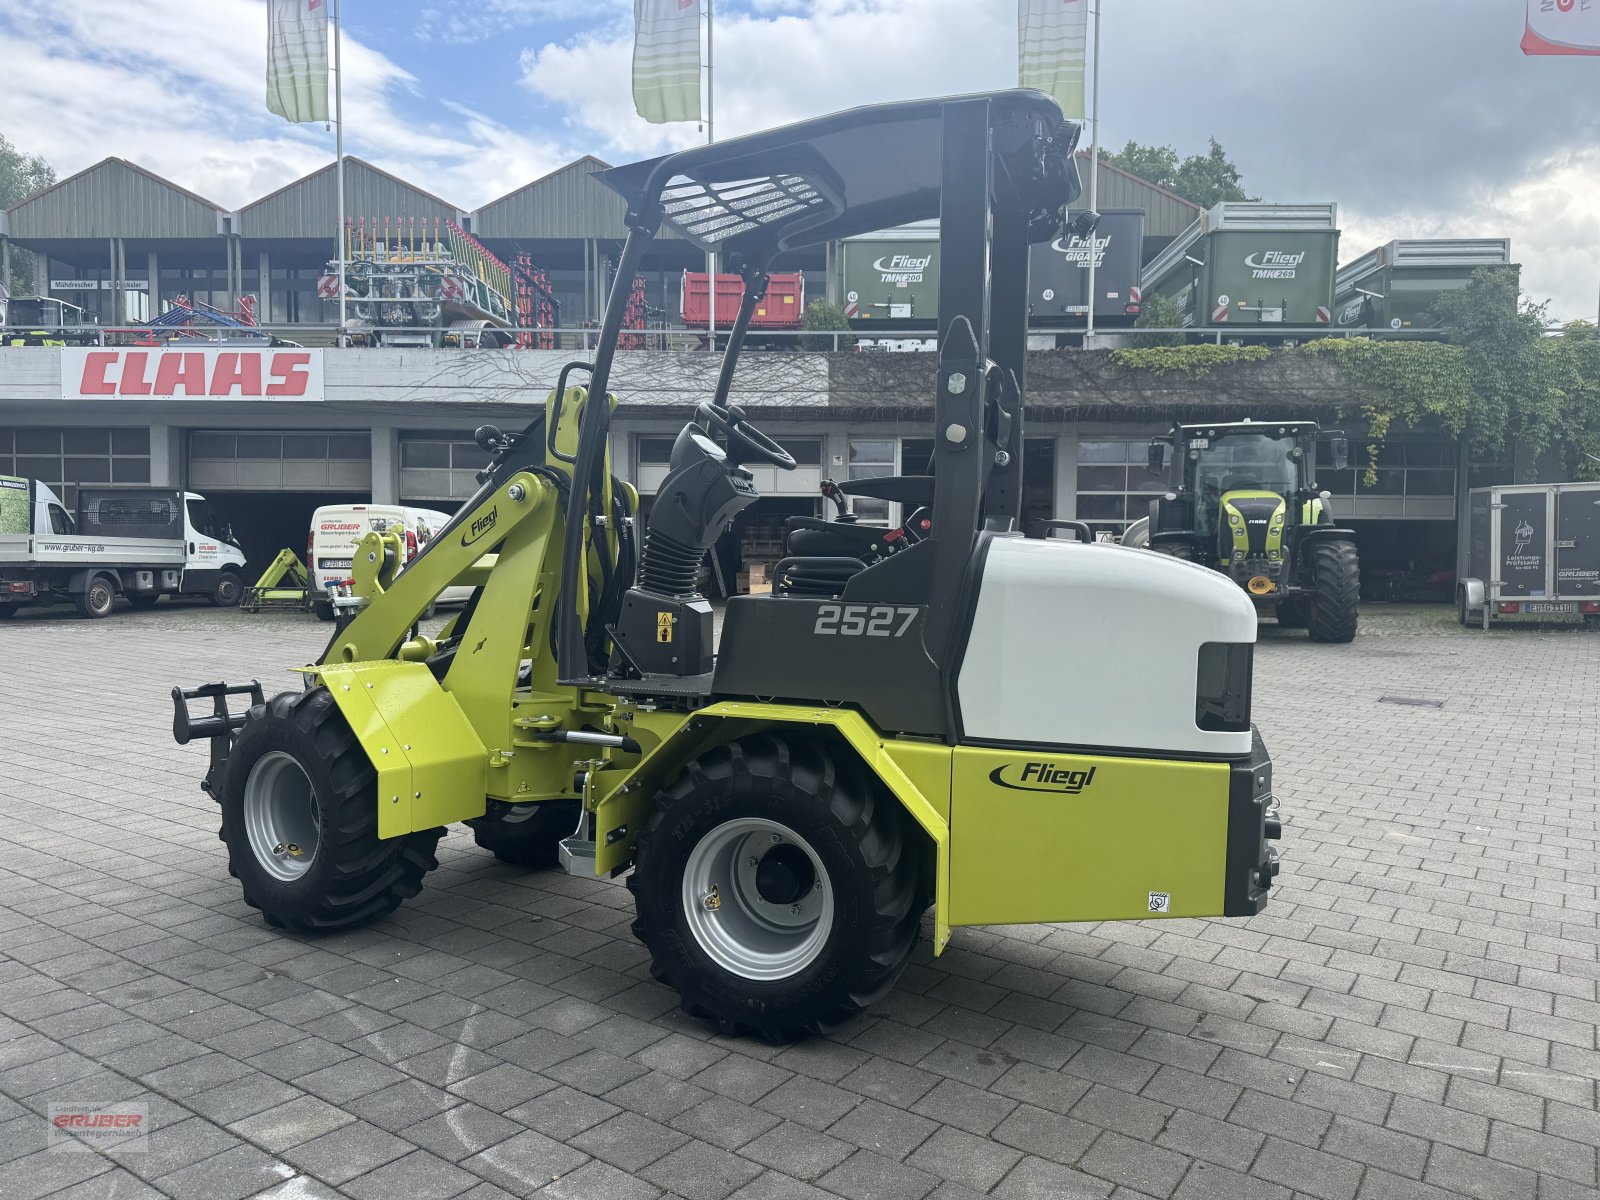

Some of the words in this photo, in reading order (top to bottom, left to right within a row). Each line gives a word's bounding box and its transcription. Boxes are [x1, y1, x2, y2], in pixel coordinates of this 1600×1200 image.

[890, 254, 932, 271] Fliegl
[1261, 251, 1305, 266] Fliegl
[881, 273, 905, 283] TMK
[905, 274, 922, 282] 200
[1252, 269, 1275, 279] TMK
[1276, 270, 1295, 278] 269
[79, 351, 311, 396] CLAAS
[471, 504, 498, 537] Fliegl
[44, 543, 105, 554] www.gruber-kg.de
[1530, 604, 1541, 612] ED
[814, 605, 920, 637] 2527
[1020, 762, 1097, 791] Fliegl
